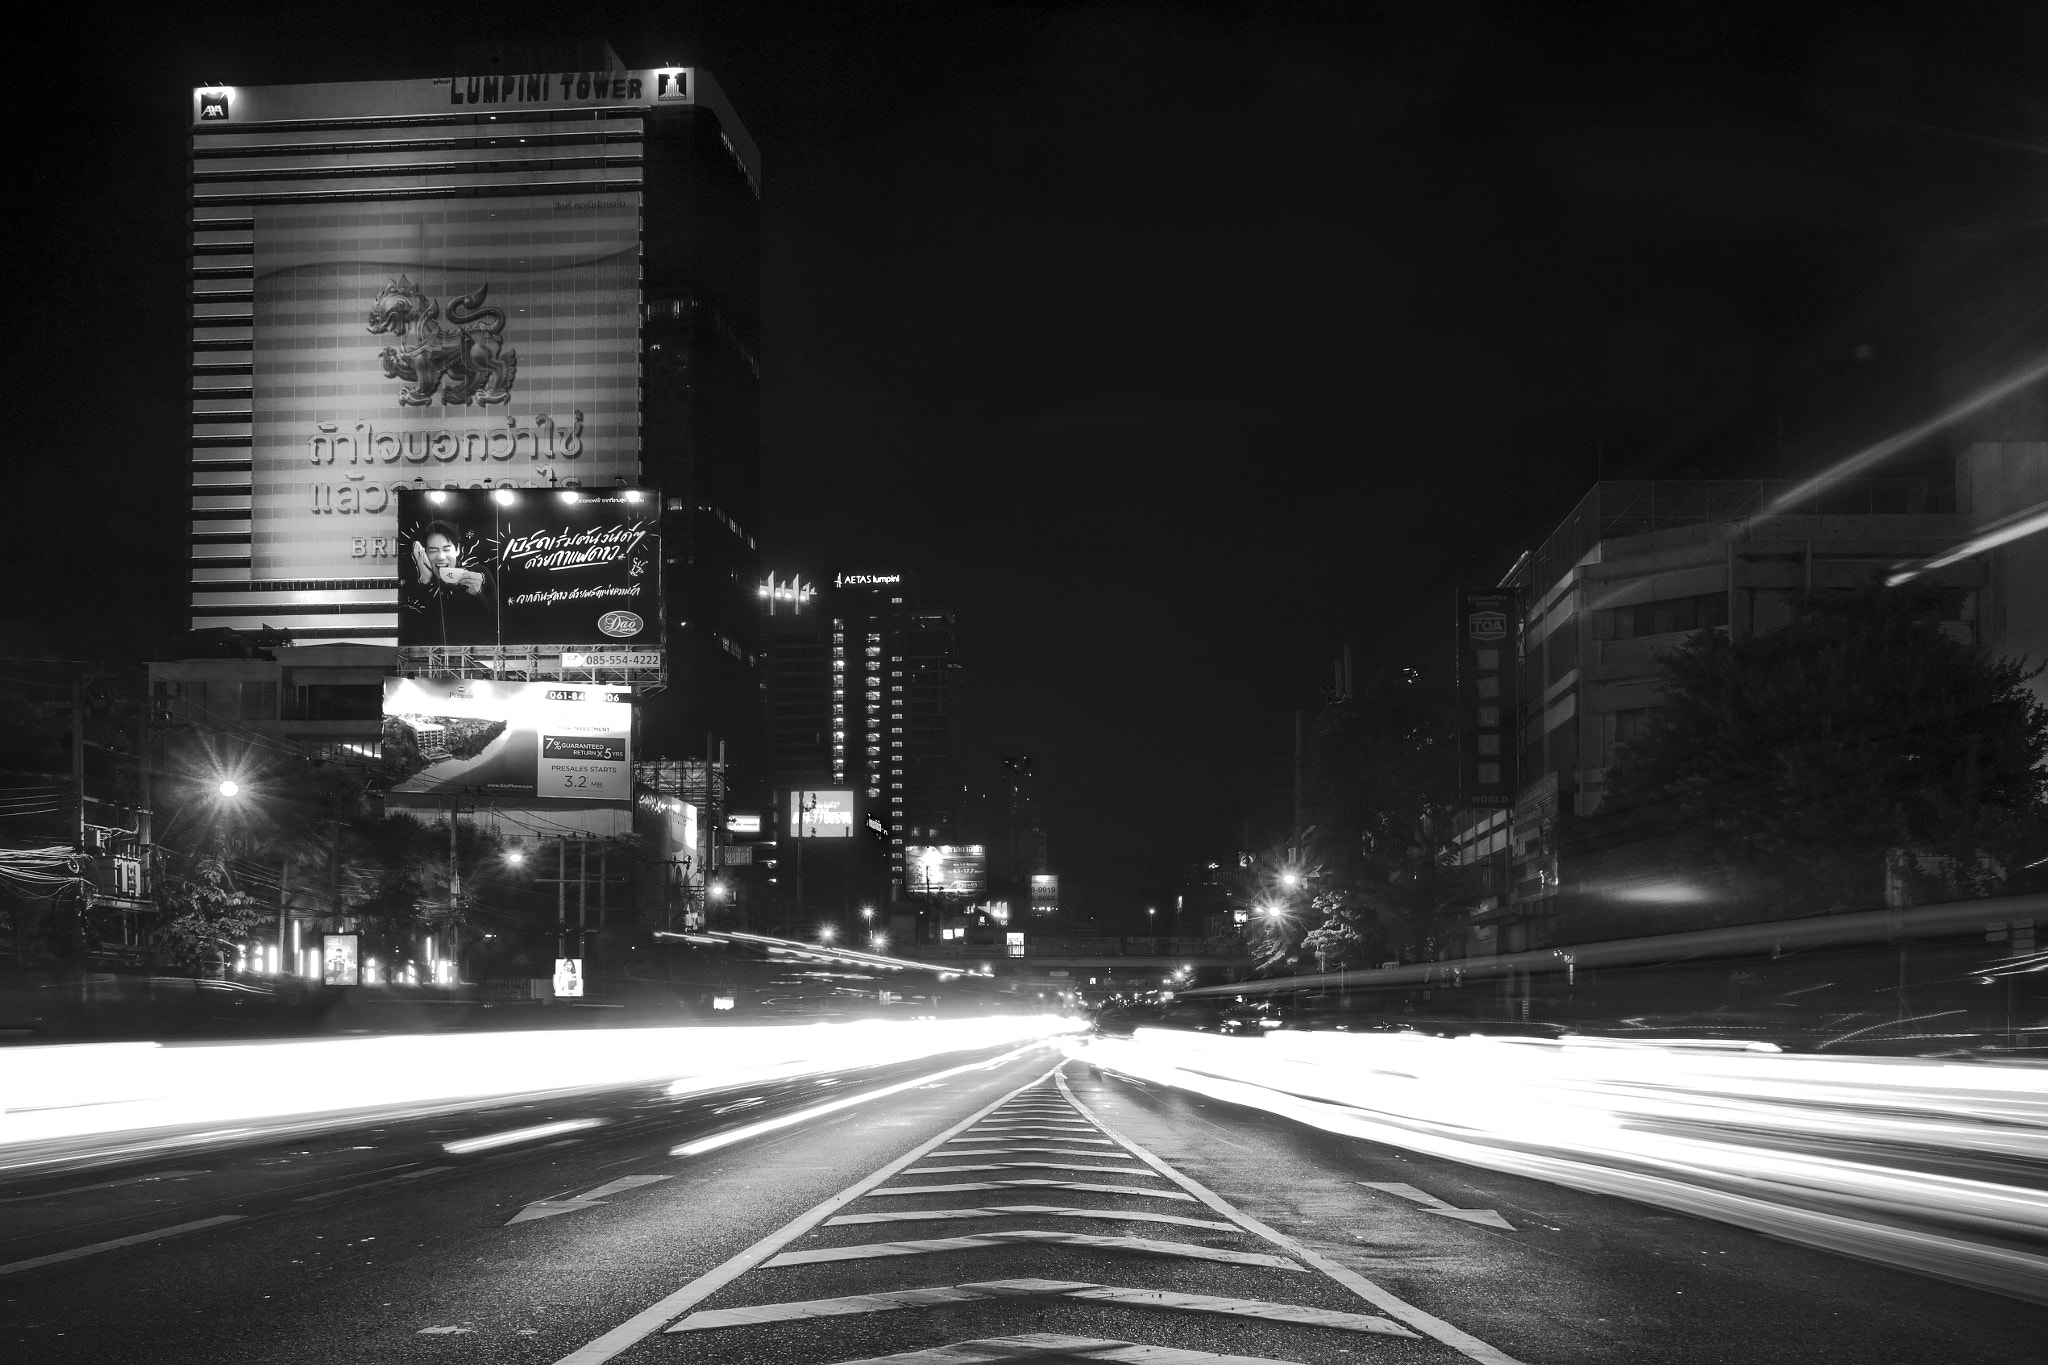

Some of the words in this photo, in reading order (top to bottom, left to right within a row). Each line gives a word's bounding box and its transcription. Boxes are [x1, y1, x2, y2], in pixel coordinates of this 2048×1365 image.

[450, 73, 550, 105] LUMPINI
[559, 71, 643, 101] TOWER
[201, 104, 224, 117] AXA
[307, 410, 585, 464] ถ้าใจบอกว่าใช่
[844, 575, 872, 584] AETAS
[604, 613, 637, 631] Dao
[1472, 620, 1503, 632] TOA
[586, 655, 659, 665] 085-554-4222
[545, 737, 562, 750] 7%
[561, 742, 604, 750] GUARANTEED
[603, 747, 612, 759] 5
[551, 764, 589, 773] PRESALES
[1471, 796, 1509, 804] WORLD
